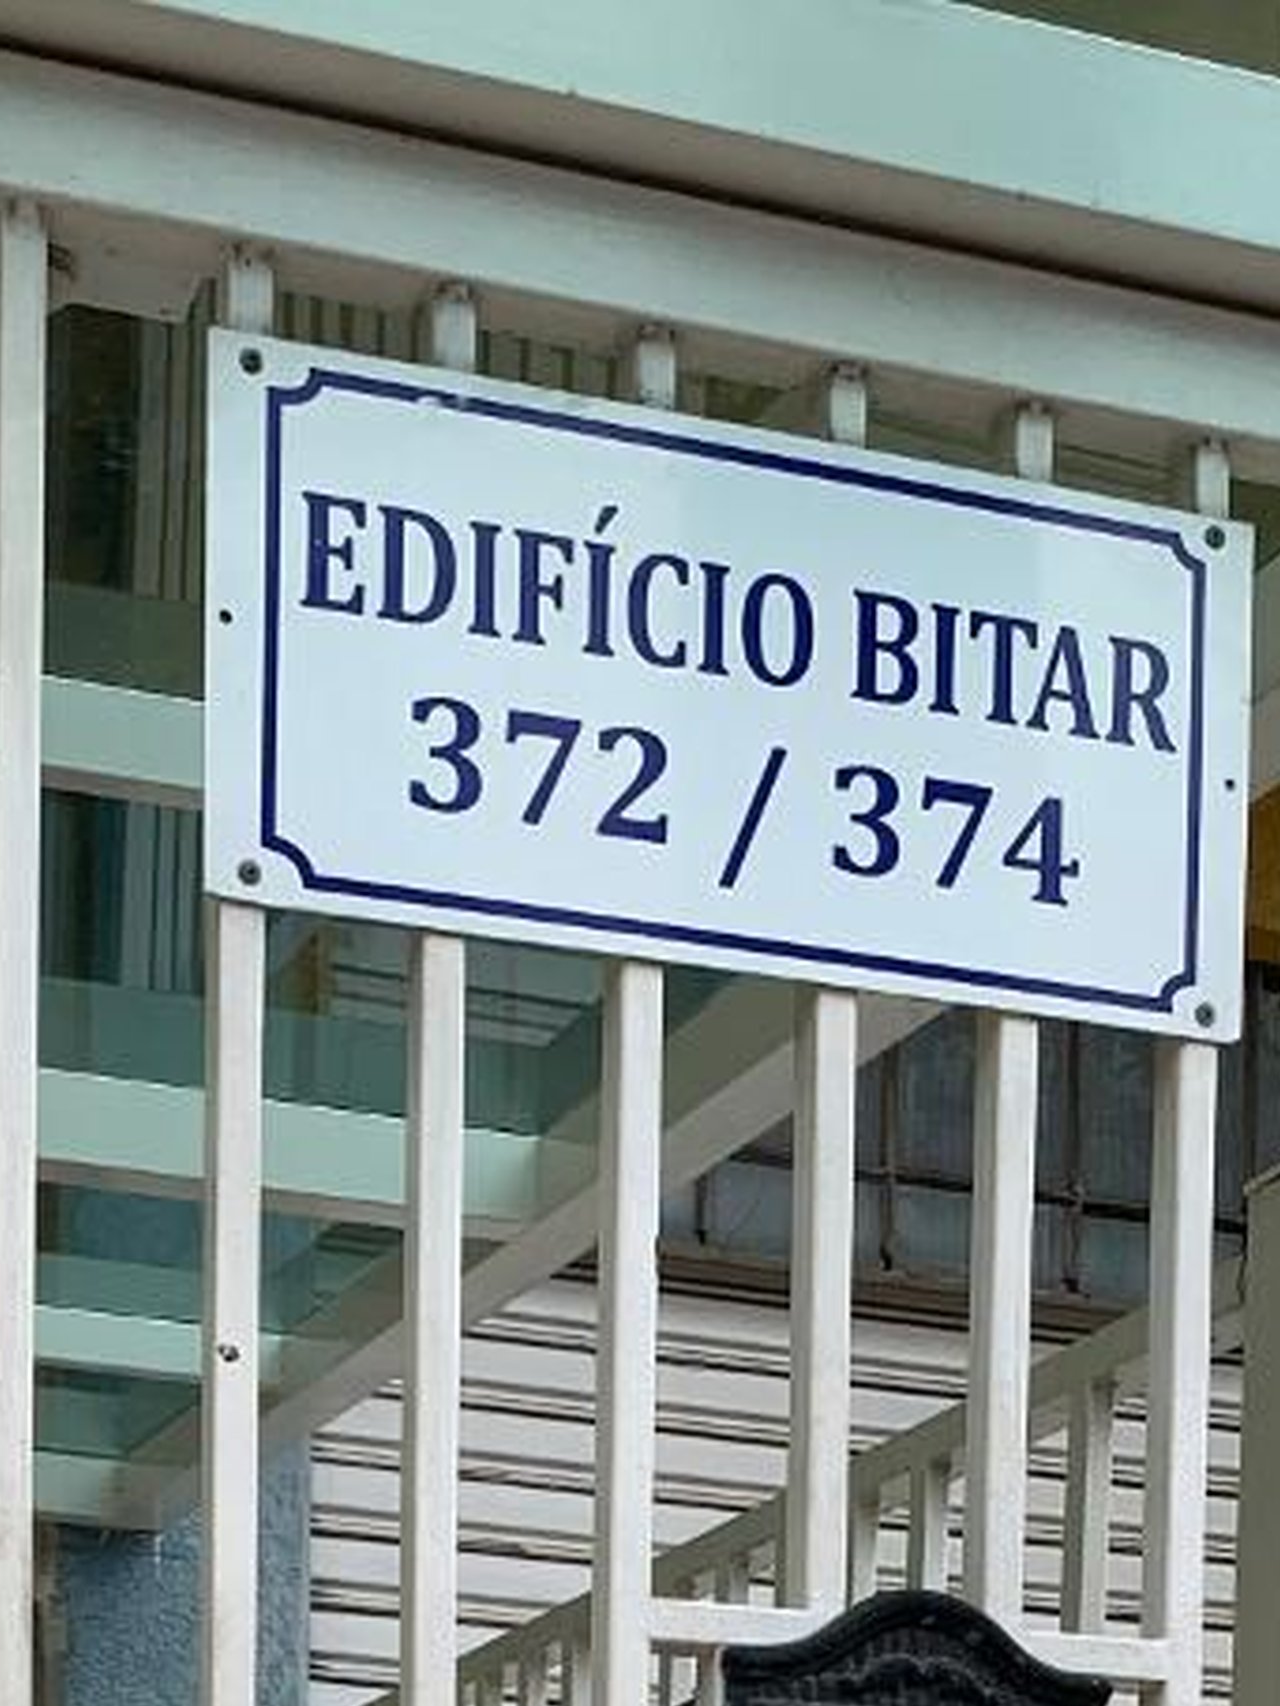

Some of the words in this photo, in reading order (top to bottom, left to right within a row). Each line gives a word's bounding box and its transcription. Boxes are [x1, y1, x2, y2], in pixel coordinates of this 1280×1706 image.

[299, 490, 815, 687] EDIFÍCIO
[850, 588, 1178, 754] BITAR
[408, 696, 670, 845] 372
[718, 746, 789, 890] /
[831, 765, 1081, 907] 374
